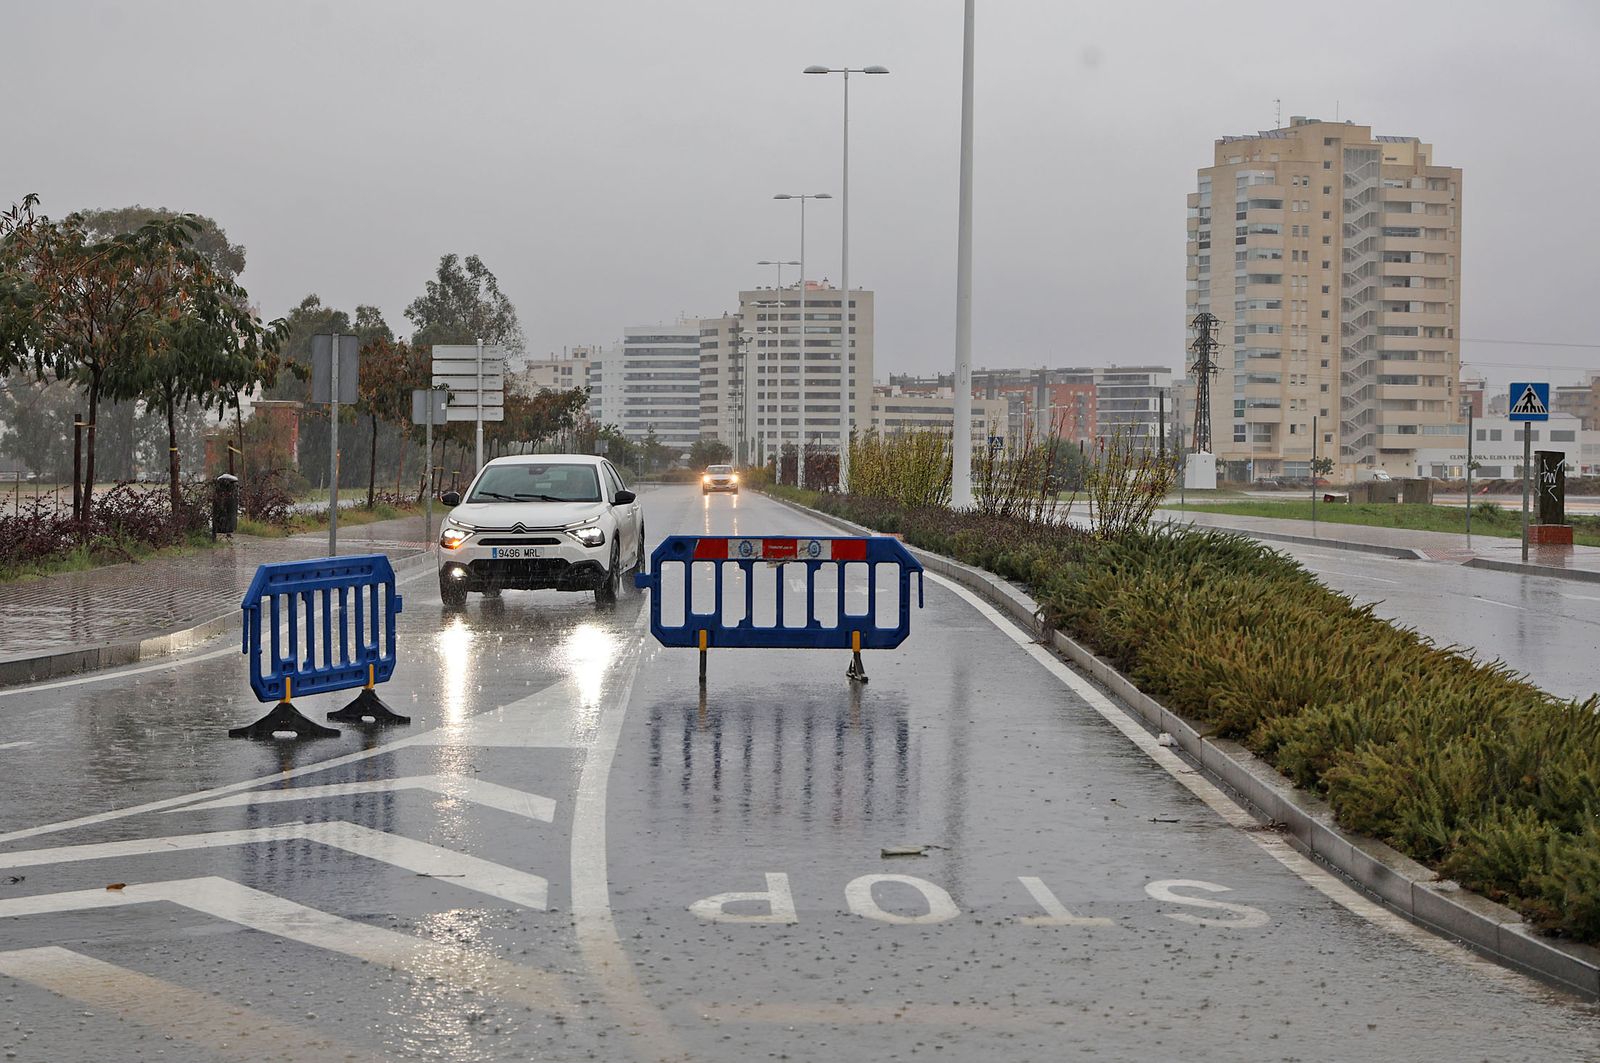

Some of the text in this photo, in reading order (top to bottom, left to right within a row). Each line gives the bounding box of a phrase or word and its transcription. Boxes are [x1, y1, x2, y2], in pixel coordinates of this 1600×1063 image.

[498, 548, 541, 558] 9496 MRL
[687, 872, 1272, 928] STOP
